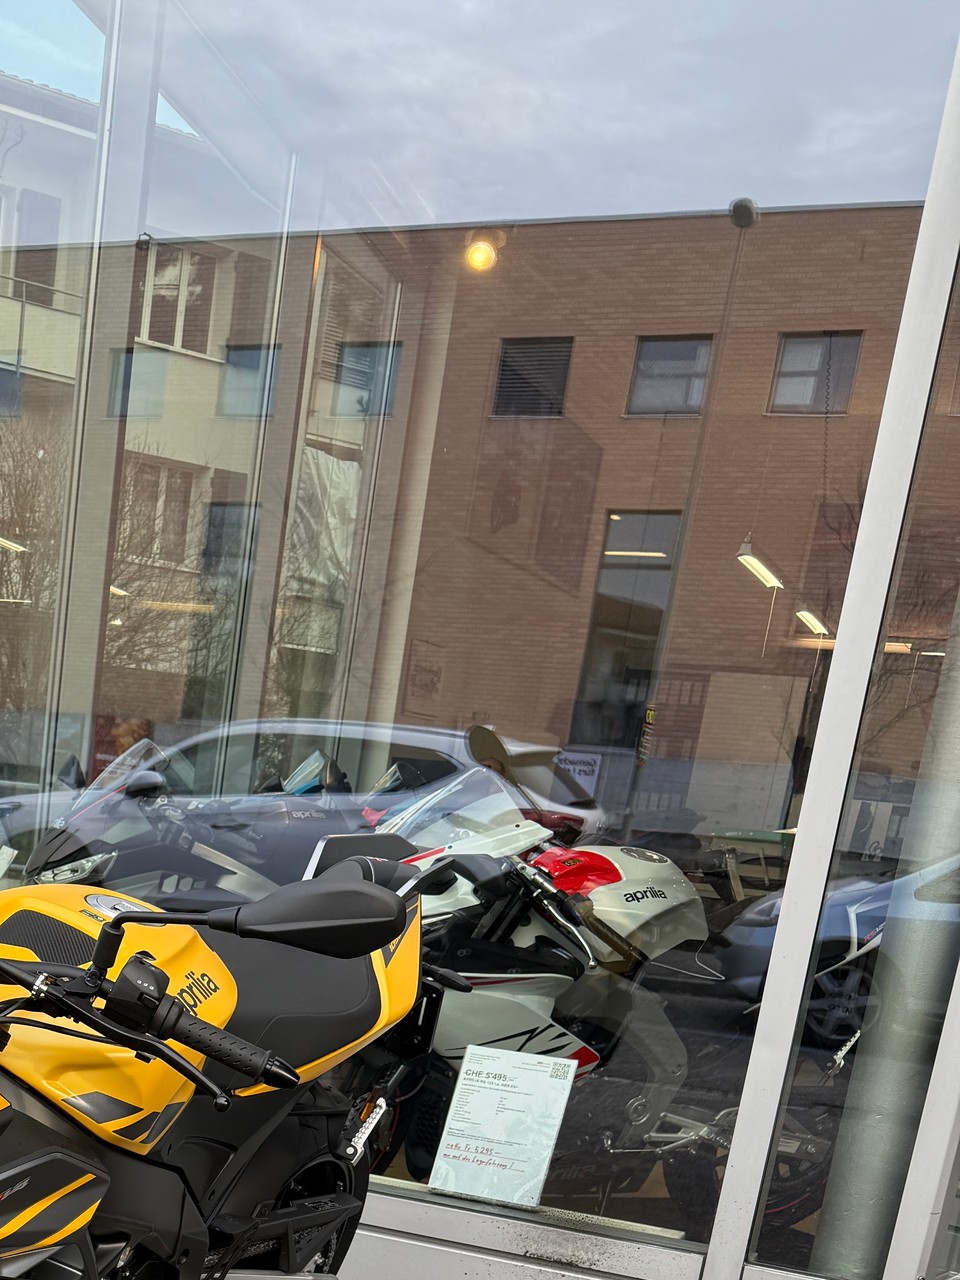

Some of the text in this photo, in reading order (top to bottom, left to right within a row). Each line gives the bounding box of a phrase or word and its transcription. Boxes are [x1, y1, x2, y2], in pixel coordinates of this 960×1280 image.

[291, 809, 326, 819] aprilia
[623, 886, 668, 903] aprilia
[176, 970, 220, 1016] prilia
[465, 1069, 484, 1078] CHF
